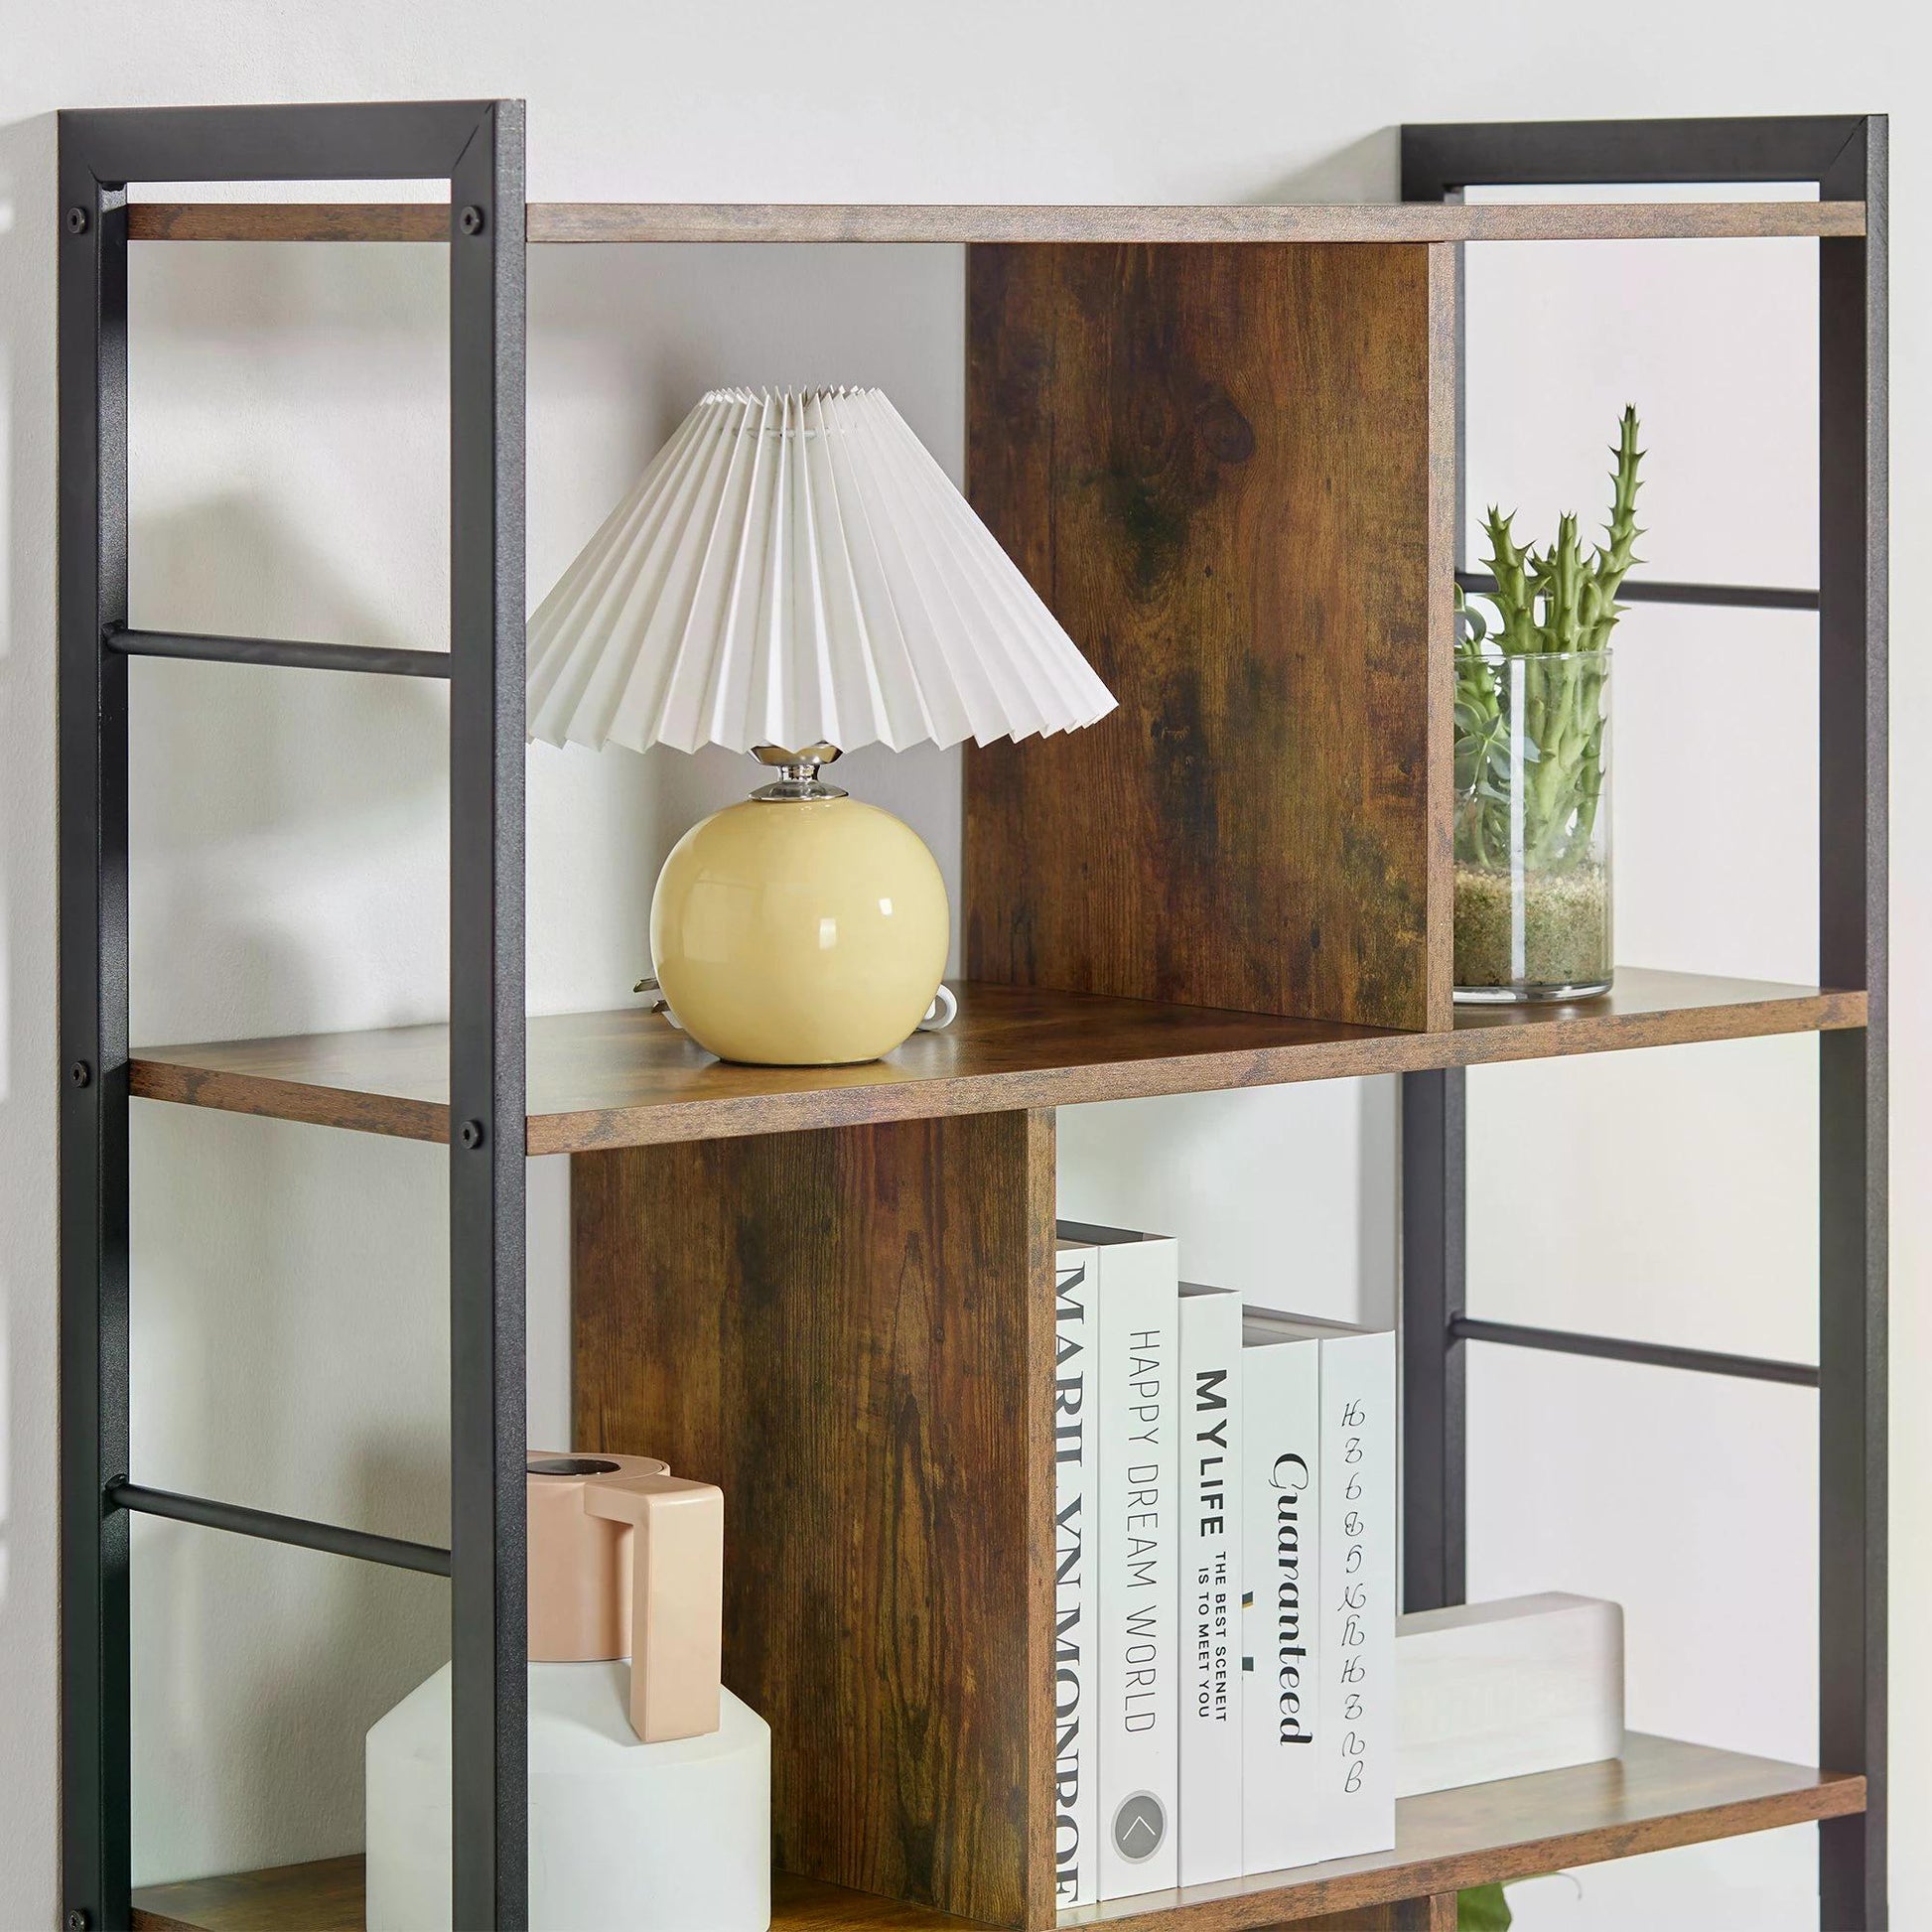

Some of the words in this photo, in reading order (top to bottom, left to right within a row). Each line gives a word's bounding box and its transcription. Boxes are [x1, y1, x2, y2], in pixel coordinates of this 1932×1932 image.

[1128, 1329, 1161, 1445] HAPPY
[1126, 1463, 1160, 1588] DREAM
[1197, 1567, 1210, 1585] IS
[1214, 1551, 1227, 1587] THE
[1197, 1590, 1210, 1616] TO
[1214, 1592, 1227, 1638] BEST
[1268, 1452, 1313, 1746] Guaranteed
[1124, 1604, 1158, 1733] WORLD
[1198, 1623, 1210, 1672] MEET
[1198, 1679, 1210, 1718] YOU
